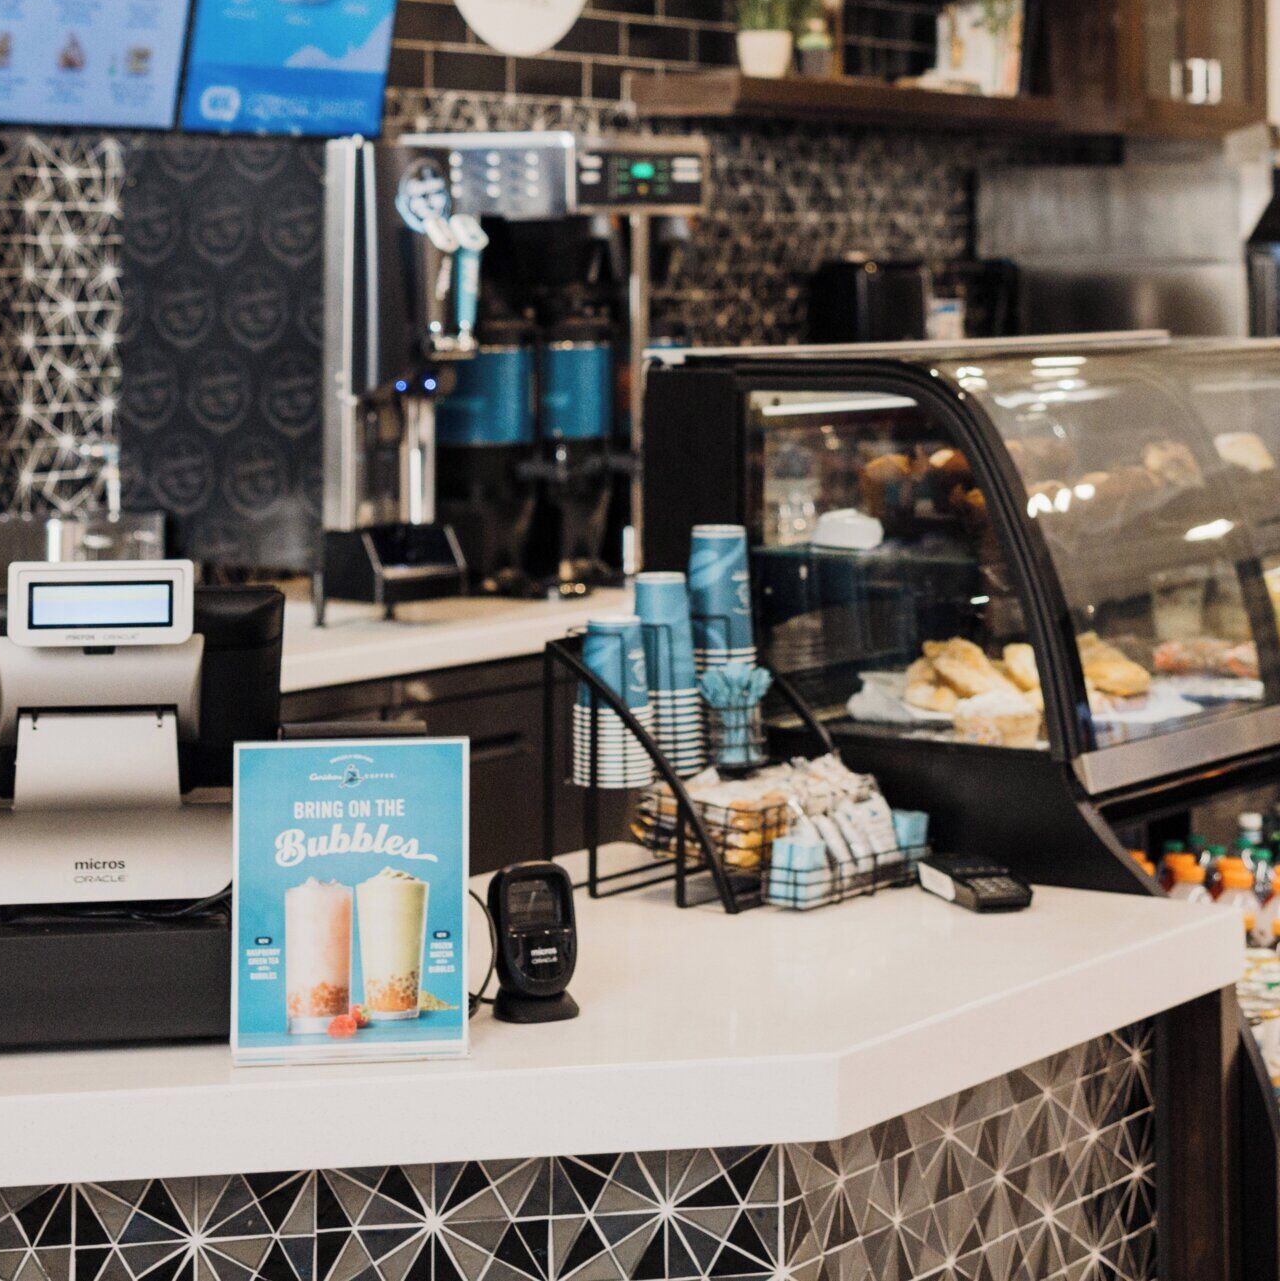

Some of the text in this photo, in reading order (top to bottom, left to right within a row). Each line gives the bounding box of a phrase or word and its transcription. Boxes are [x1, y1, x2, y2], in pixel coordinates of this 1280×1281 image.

[293, 798, 406, 820] BRING ON THE
[274, 821, 439, 868] Bubbles
[74, 857, 126, 871] micros
[73, 875, 129, 884] ORACLE
